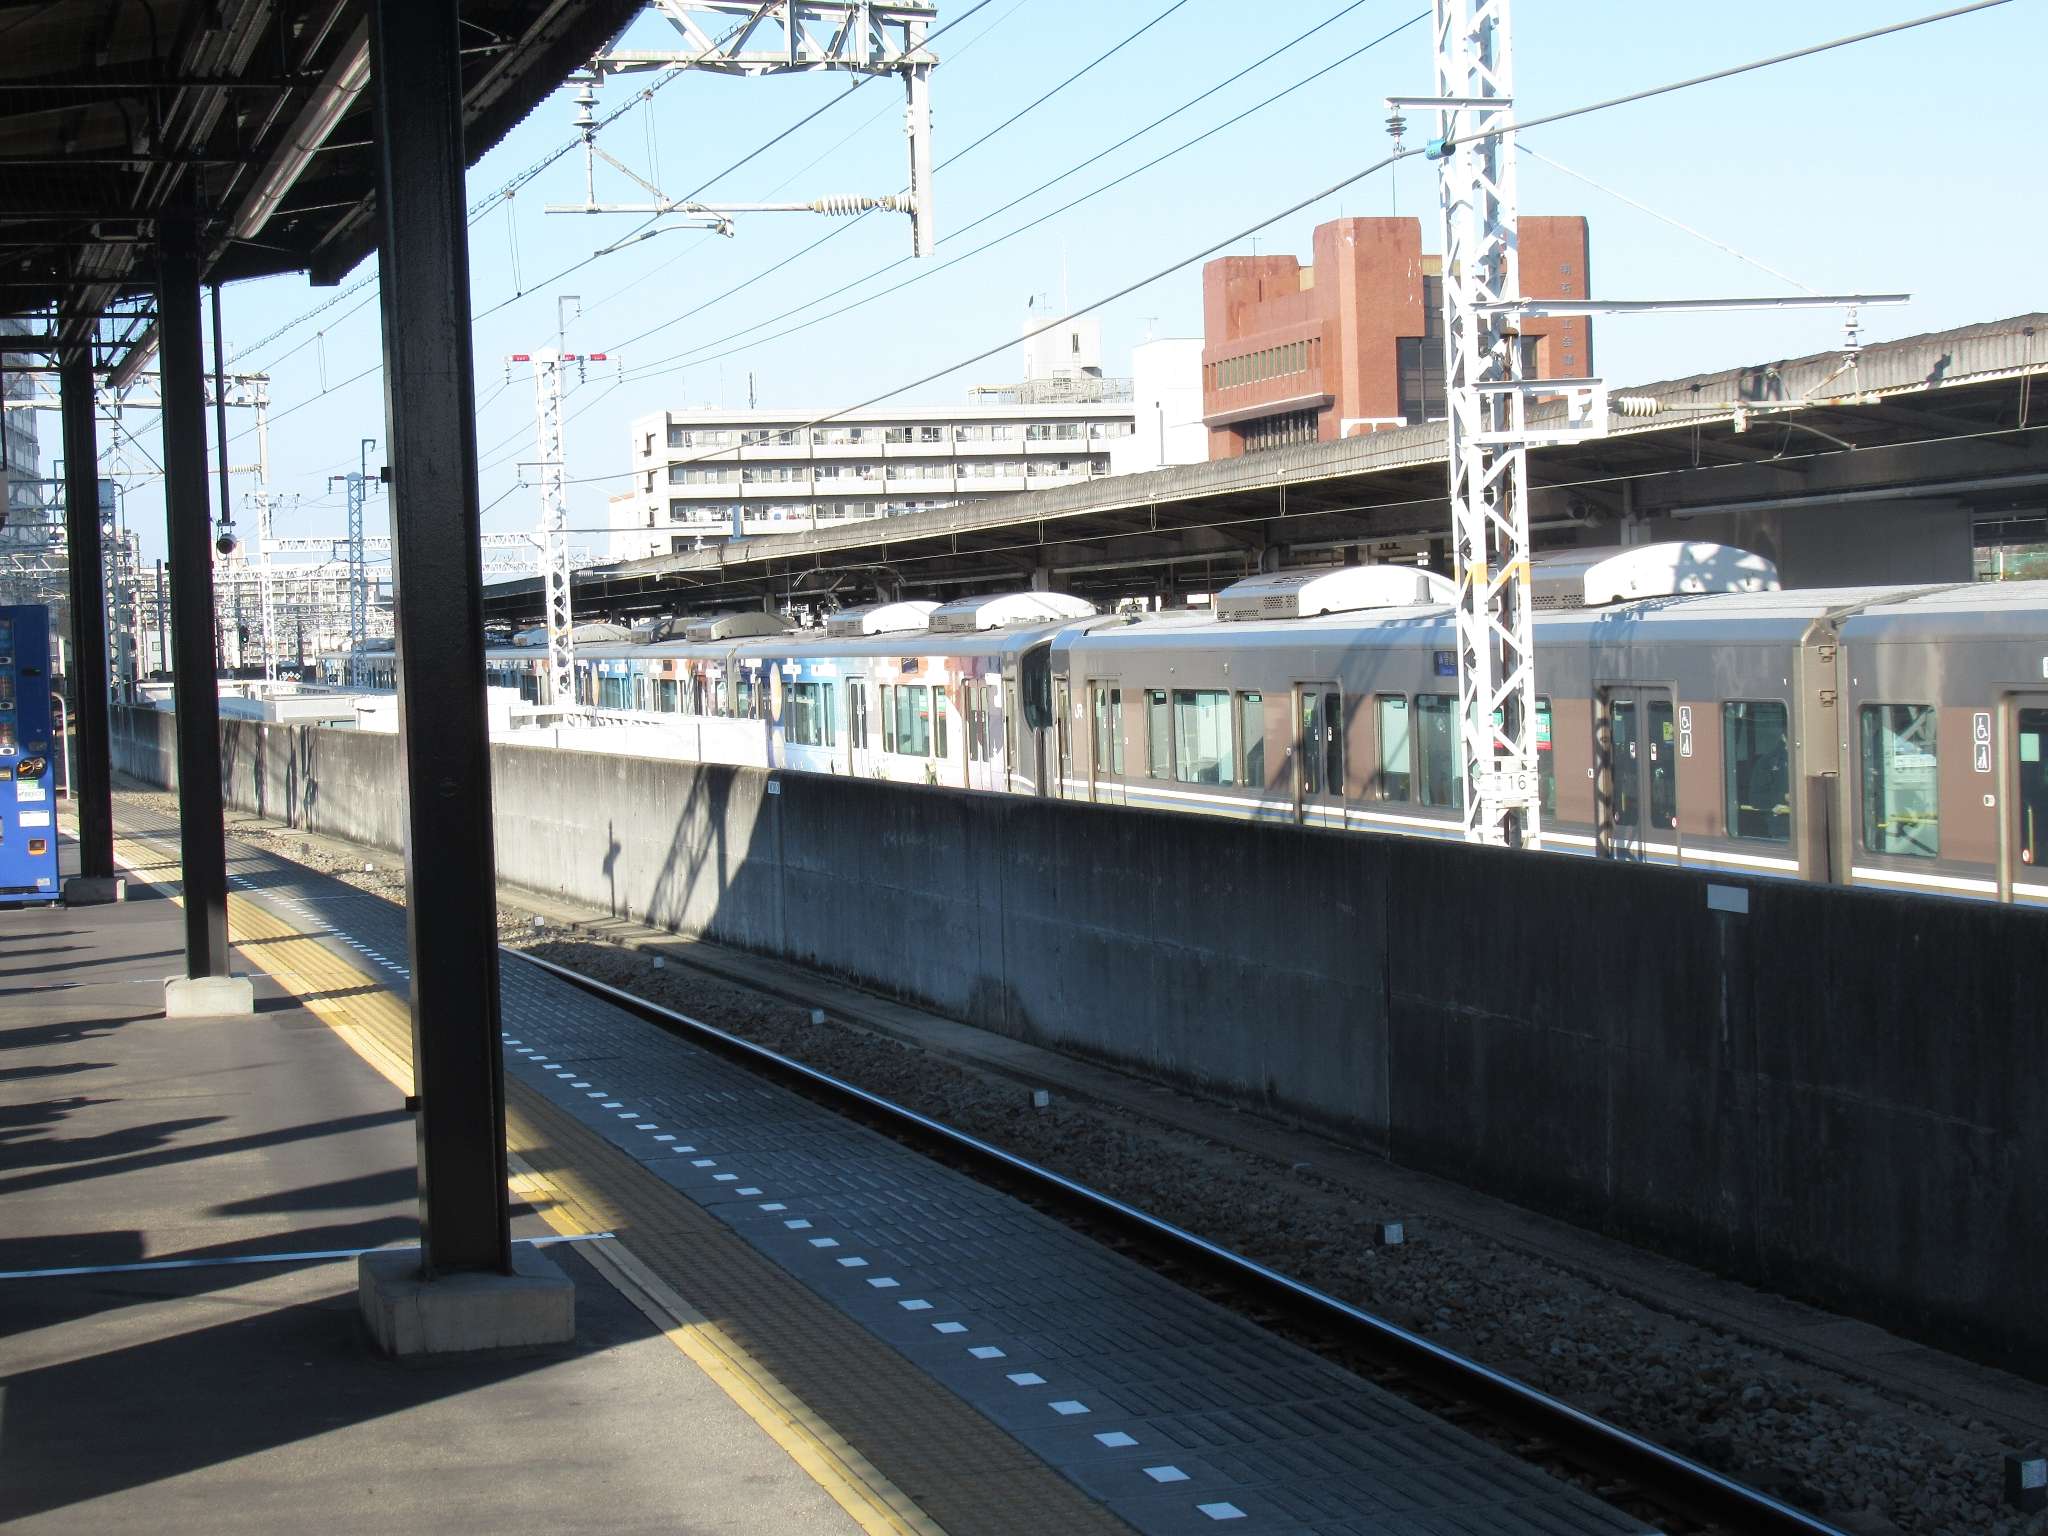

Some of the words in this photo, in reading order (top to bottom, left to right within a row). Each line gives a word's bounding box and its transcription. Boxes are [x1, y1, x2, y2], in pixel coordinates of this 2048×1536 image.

[1560, 262, 1575, 379] 明石工会
[1074, 703, 1083, 719] JR
[1509, 774, 1527, 790] 16
